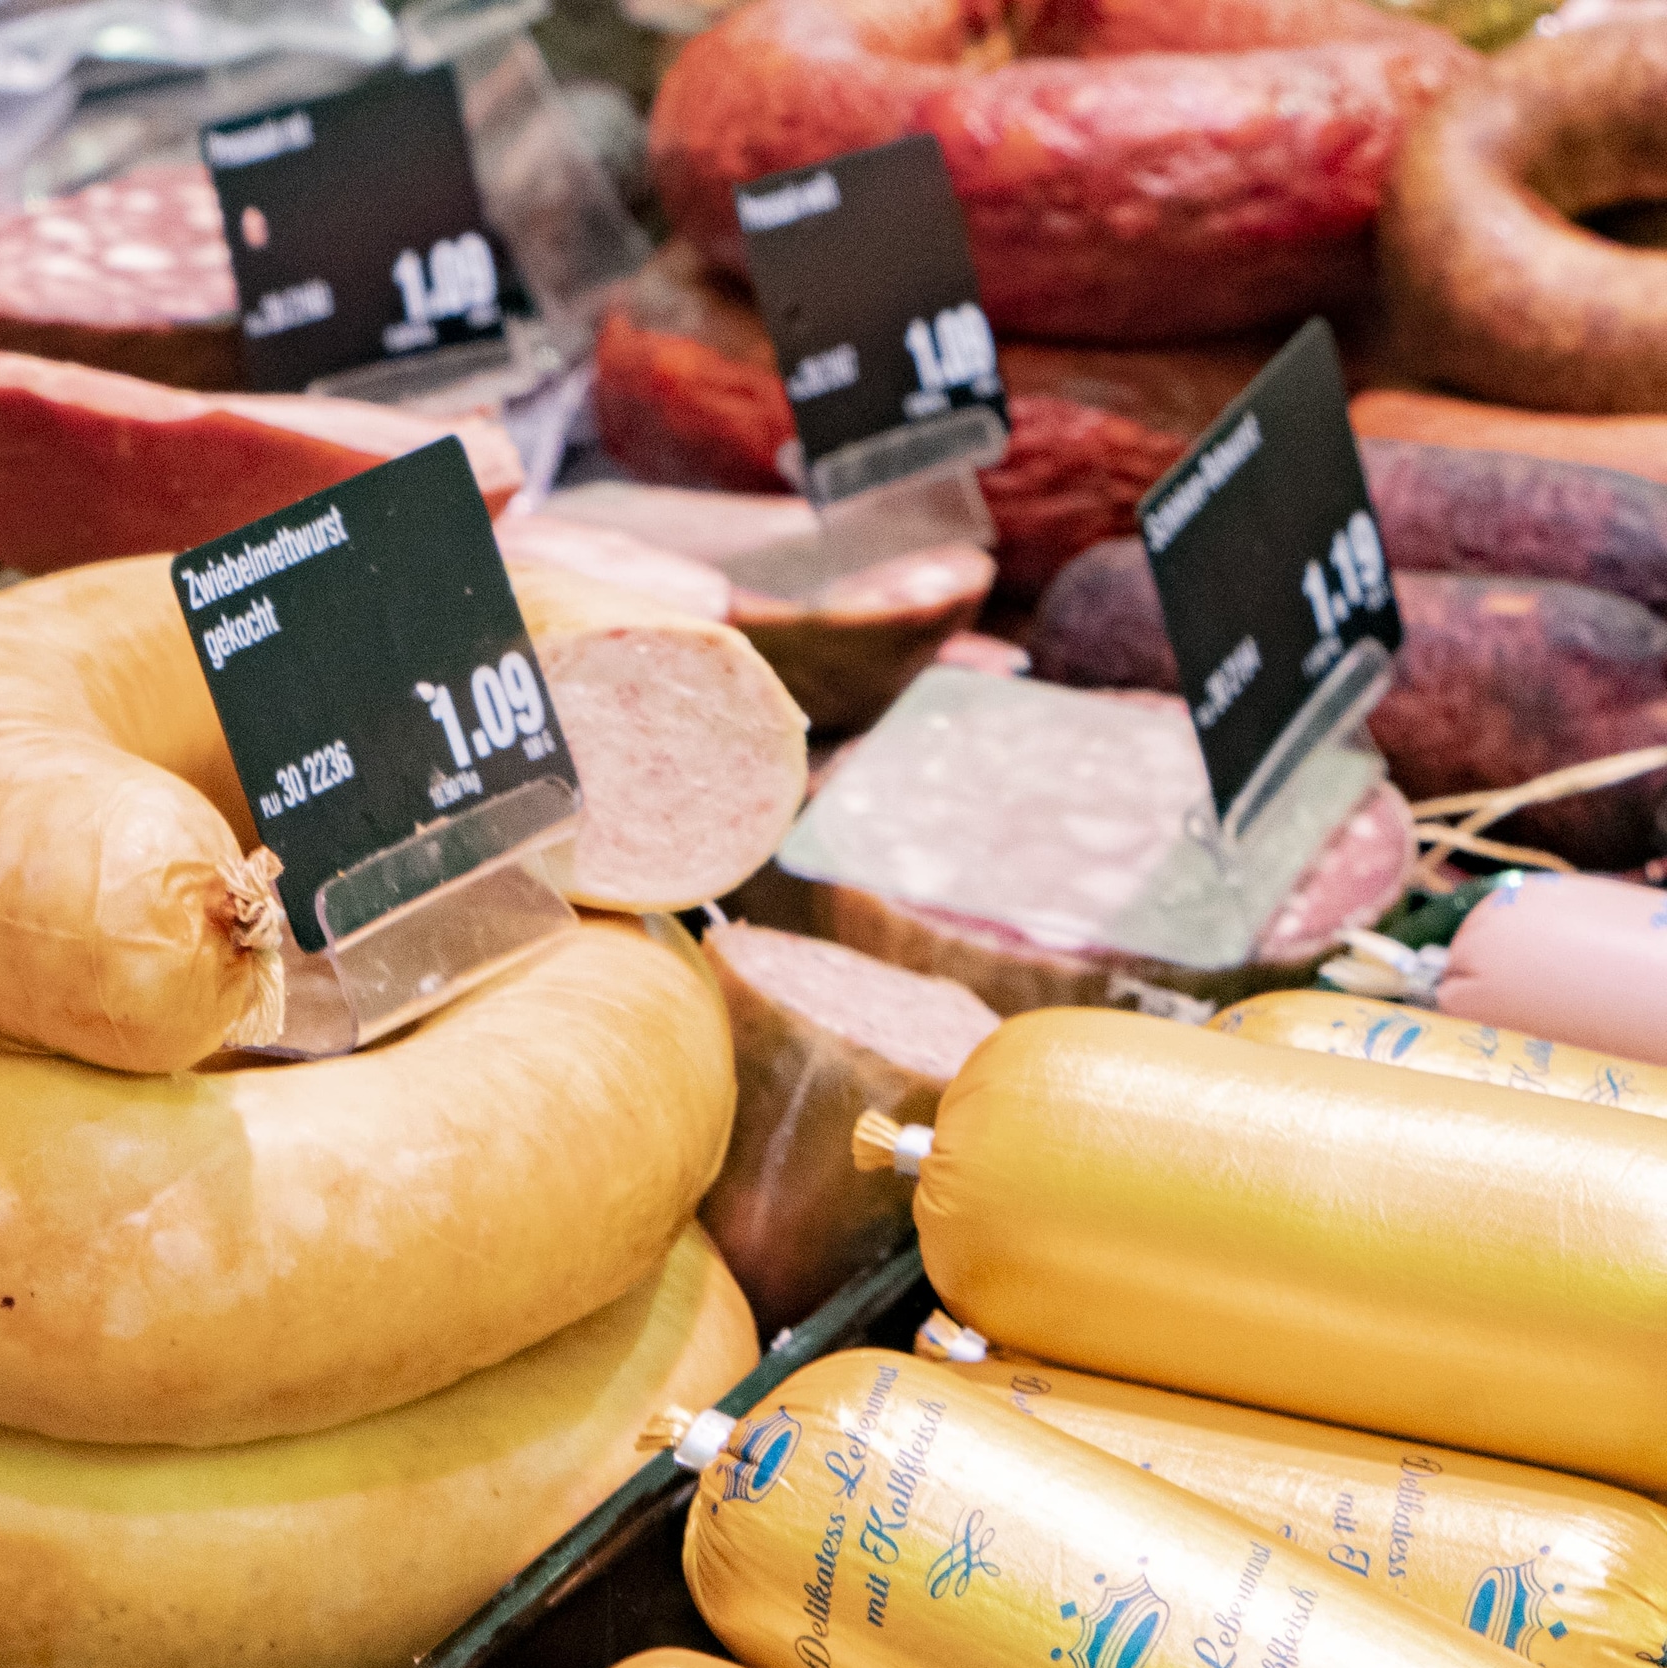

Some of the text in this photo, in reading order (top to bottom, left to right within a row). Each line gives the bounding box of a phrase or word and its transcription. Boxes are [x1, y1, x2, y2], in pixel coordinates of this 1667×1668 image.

[182, 505, 348, 611] Zwiebelmettwurst
[202, 595, 281, 671] gekocht
[429, 651, 545, 769] 1.09
[275, 765, 302, 808] 30
[302, 740, 355, 796] 2236
[860, 1397, 947, 1628] mit Kalbfleisch
[1332, 1491, 1354, 1534] mit
